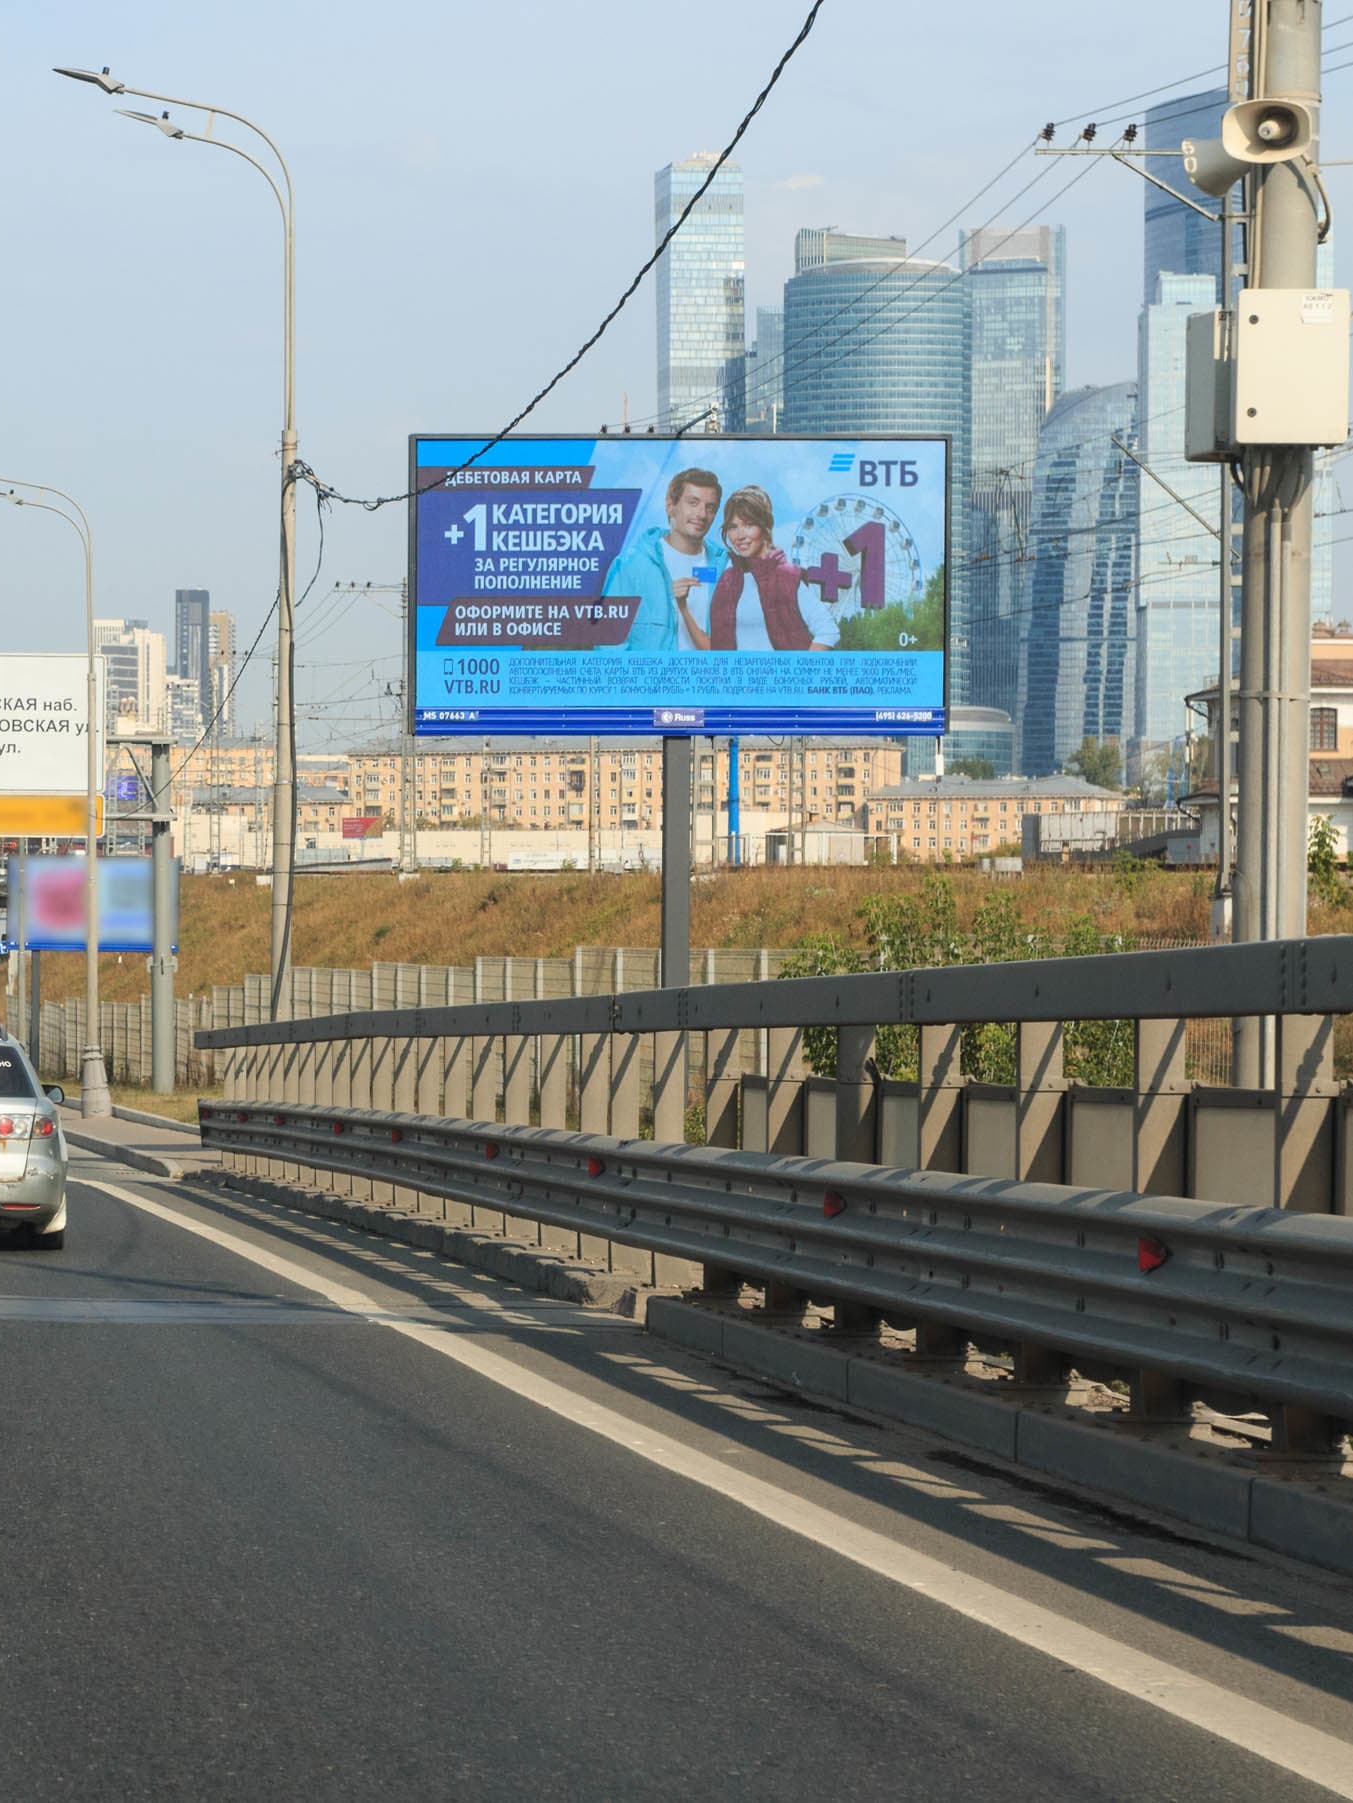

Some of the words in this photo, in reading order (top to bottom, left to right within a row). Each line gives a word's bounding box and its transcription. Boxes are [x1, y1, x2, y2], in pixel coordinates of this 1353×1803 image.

[444, 471, 530, 486] ДЕБЕТОВАЯ
[534, 471, 582, 484] КАРТА
[859, 460, 919, 487] ВТБ
[492, 504, 623, 525] КАТЕГОРИЯ
[444, 504, 486, 551] +1
[492, 530, 605, 552] КЕШБЭКА
[474, 558, 496, 572] ЗА
[500, 558, 599, 572] РЕГУЛЯРНОЕ
[807, 521, 885, 609] +1
[474, 575, 582, 590] ПОПОЛНЕНИЕ
[455, 605, 543, 620] ОФОРМИТЕ
[548, 606, 570, 619] НА
[574, 606, 629, 618] VTB.RU
[455, 622, 488, 636] ИЛИ
[492, 623, 502, 636] В
[506, 622, 562, 636] ОФИСЕ
[898, 632, 918, 646] 0+
[458, 658, 500, 675] 1000
[444, 680, 500, 694] VTB.RU
[43, 698, 78, 712] наб.
[674, 713, 696, 722] Russ
